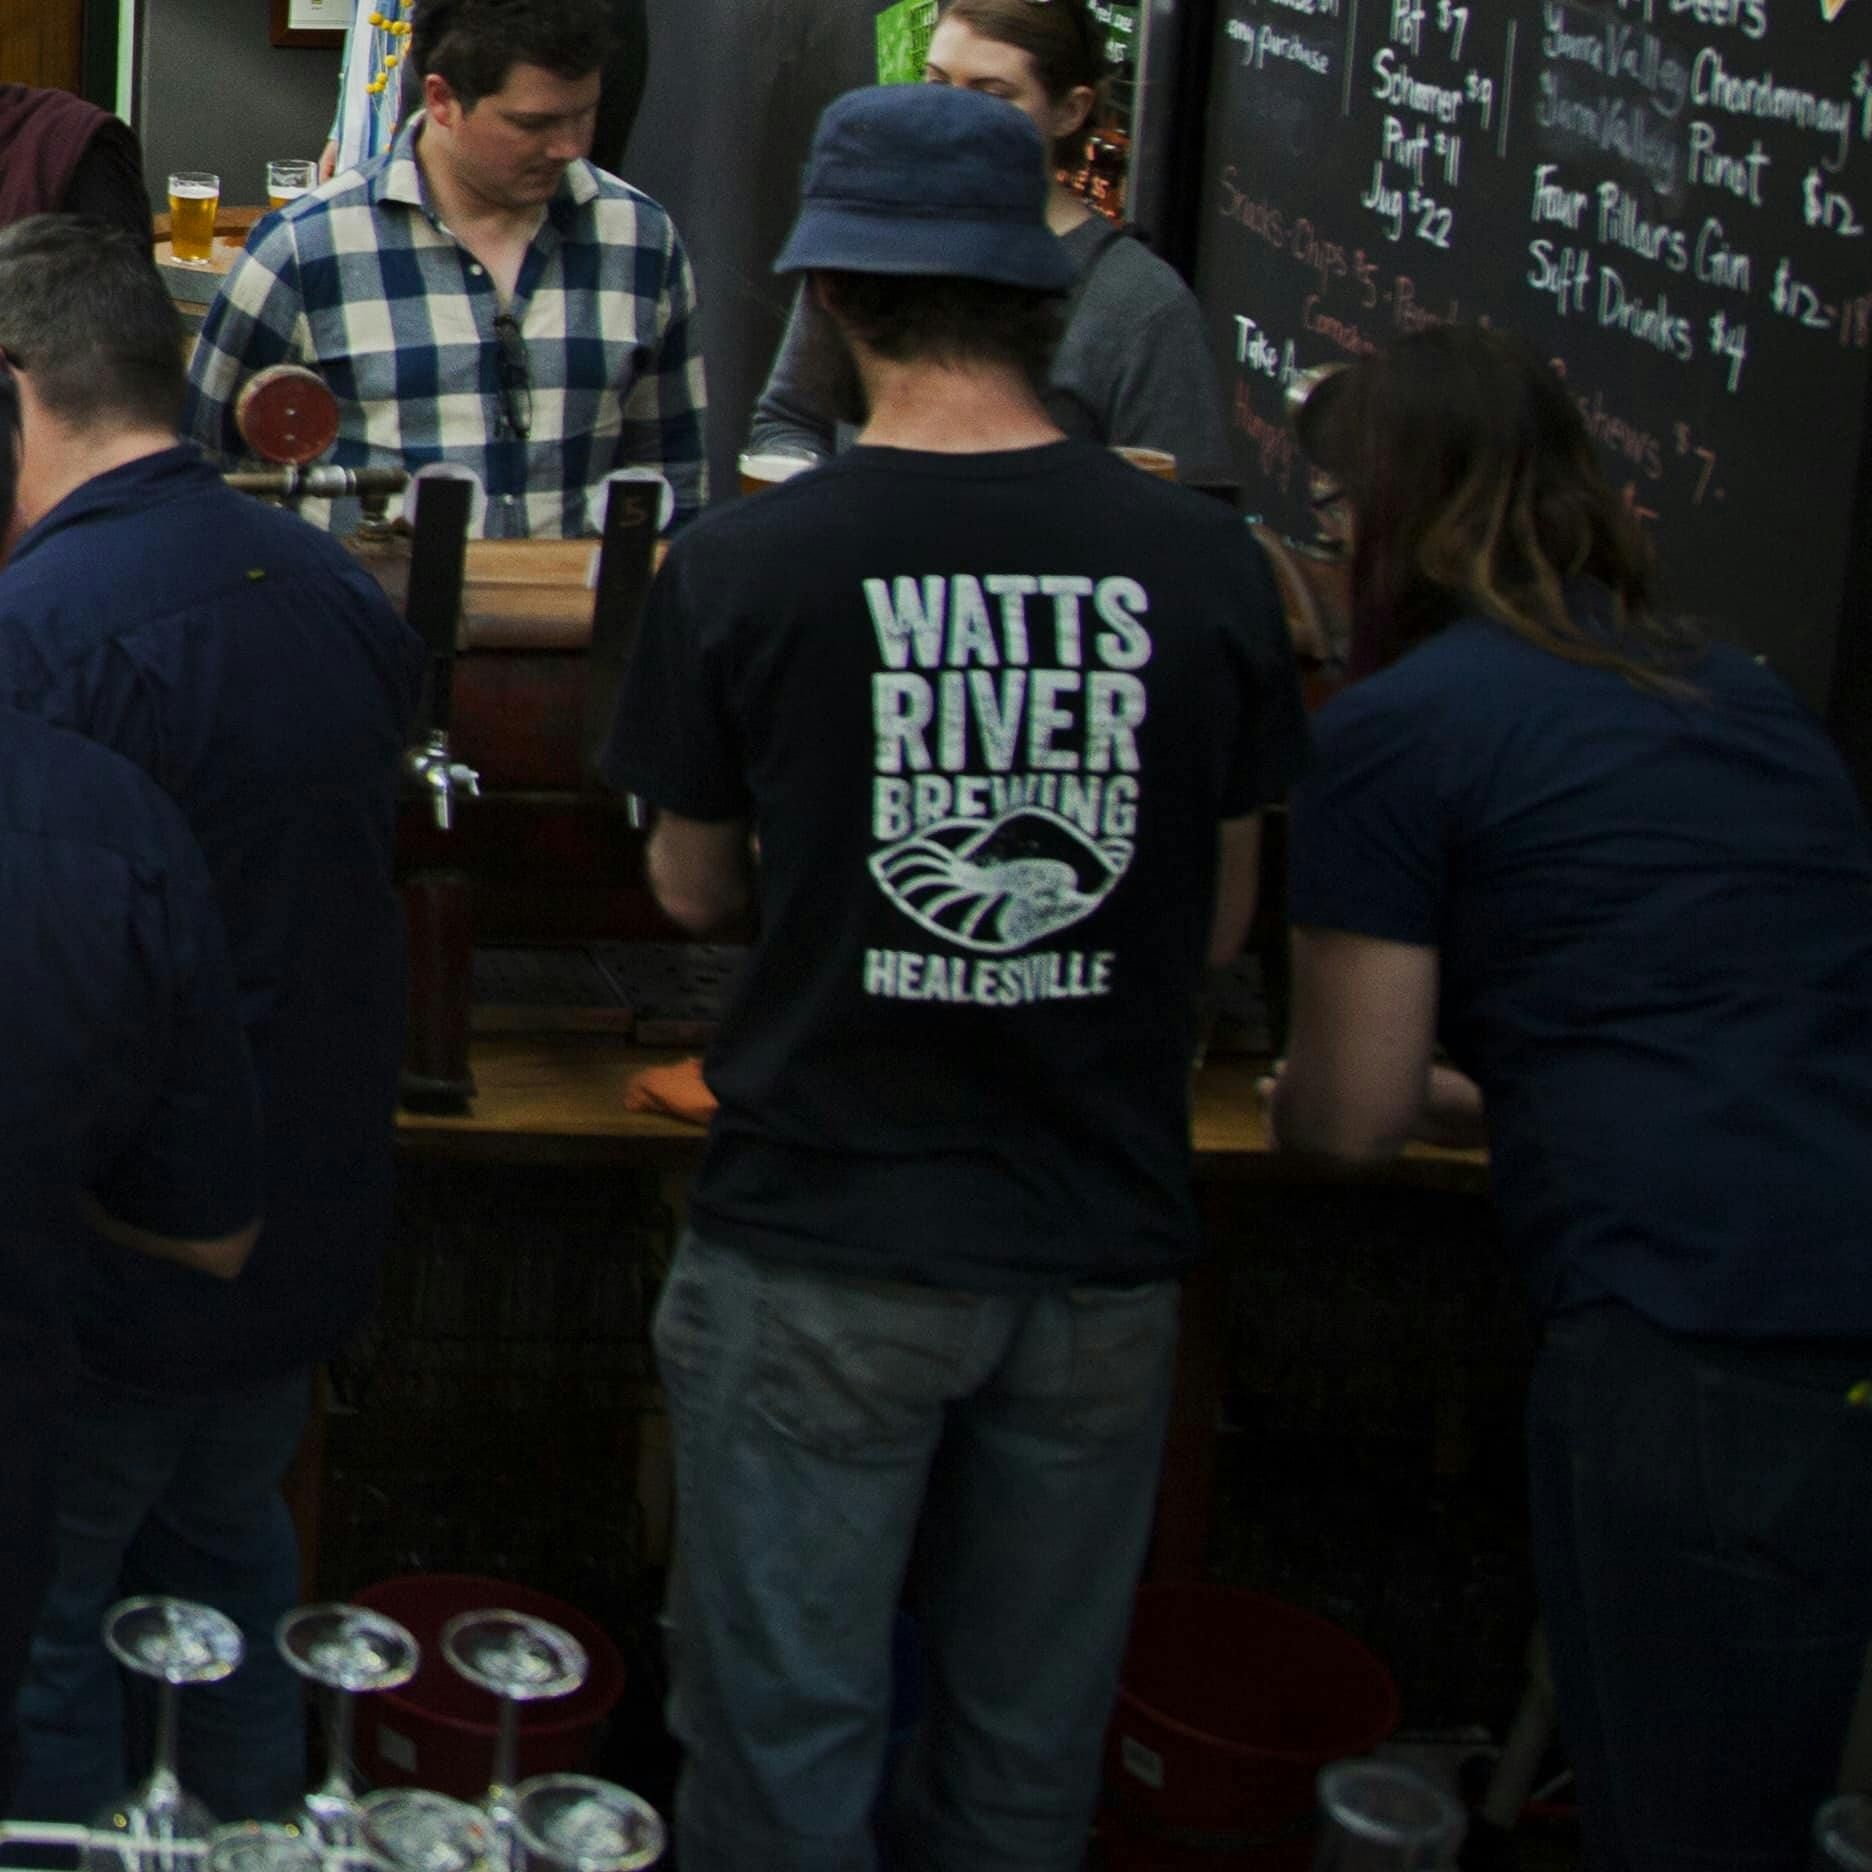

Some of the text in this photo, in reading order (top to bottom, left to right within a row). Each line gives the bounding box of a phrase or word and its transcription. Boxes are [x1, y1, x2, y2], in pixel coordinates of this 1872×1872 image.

[1372, 48, 1492, 130] Schooner $9
[1382, 115, 1429, 187] Pint
[1688, 121, 1771, 207] Pinot
[1803, 167, 1863, 235] $12
[1361, 160, 1453, 249] Jug $22
[1597, 181, 1688, 272] Pillars
[1695, 217, 1750, 294] Gin
[1770, 256, 1831, 328] $12
[1233, 314, 1278, 378] Take
[1527, 239, 1590, 316] Soft
[1599, 265, 1693, 362] Drinks
[1709, 309, 1748, 394] $4
[862, 574, 1153, 670] WATTS
[870, 669, 1147, 774] RIVER
[870, 775, 1140, 841] BREWING
[862, 948, 1115, 1006] HEALESVILLE
